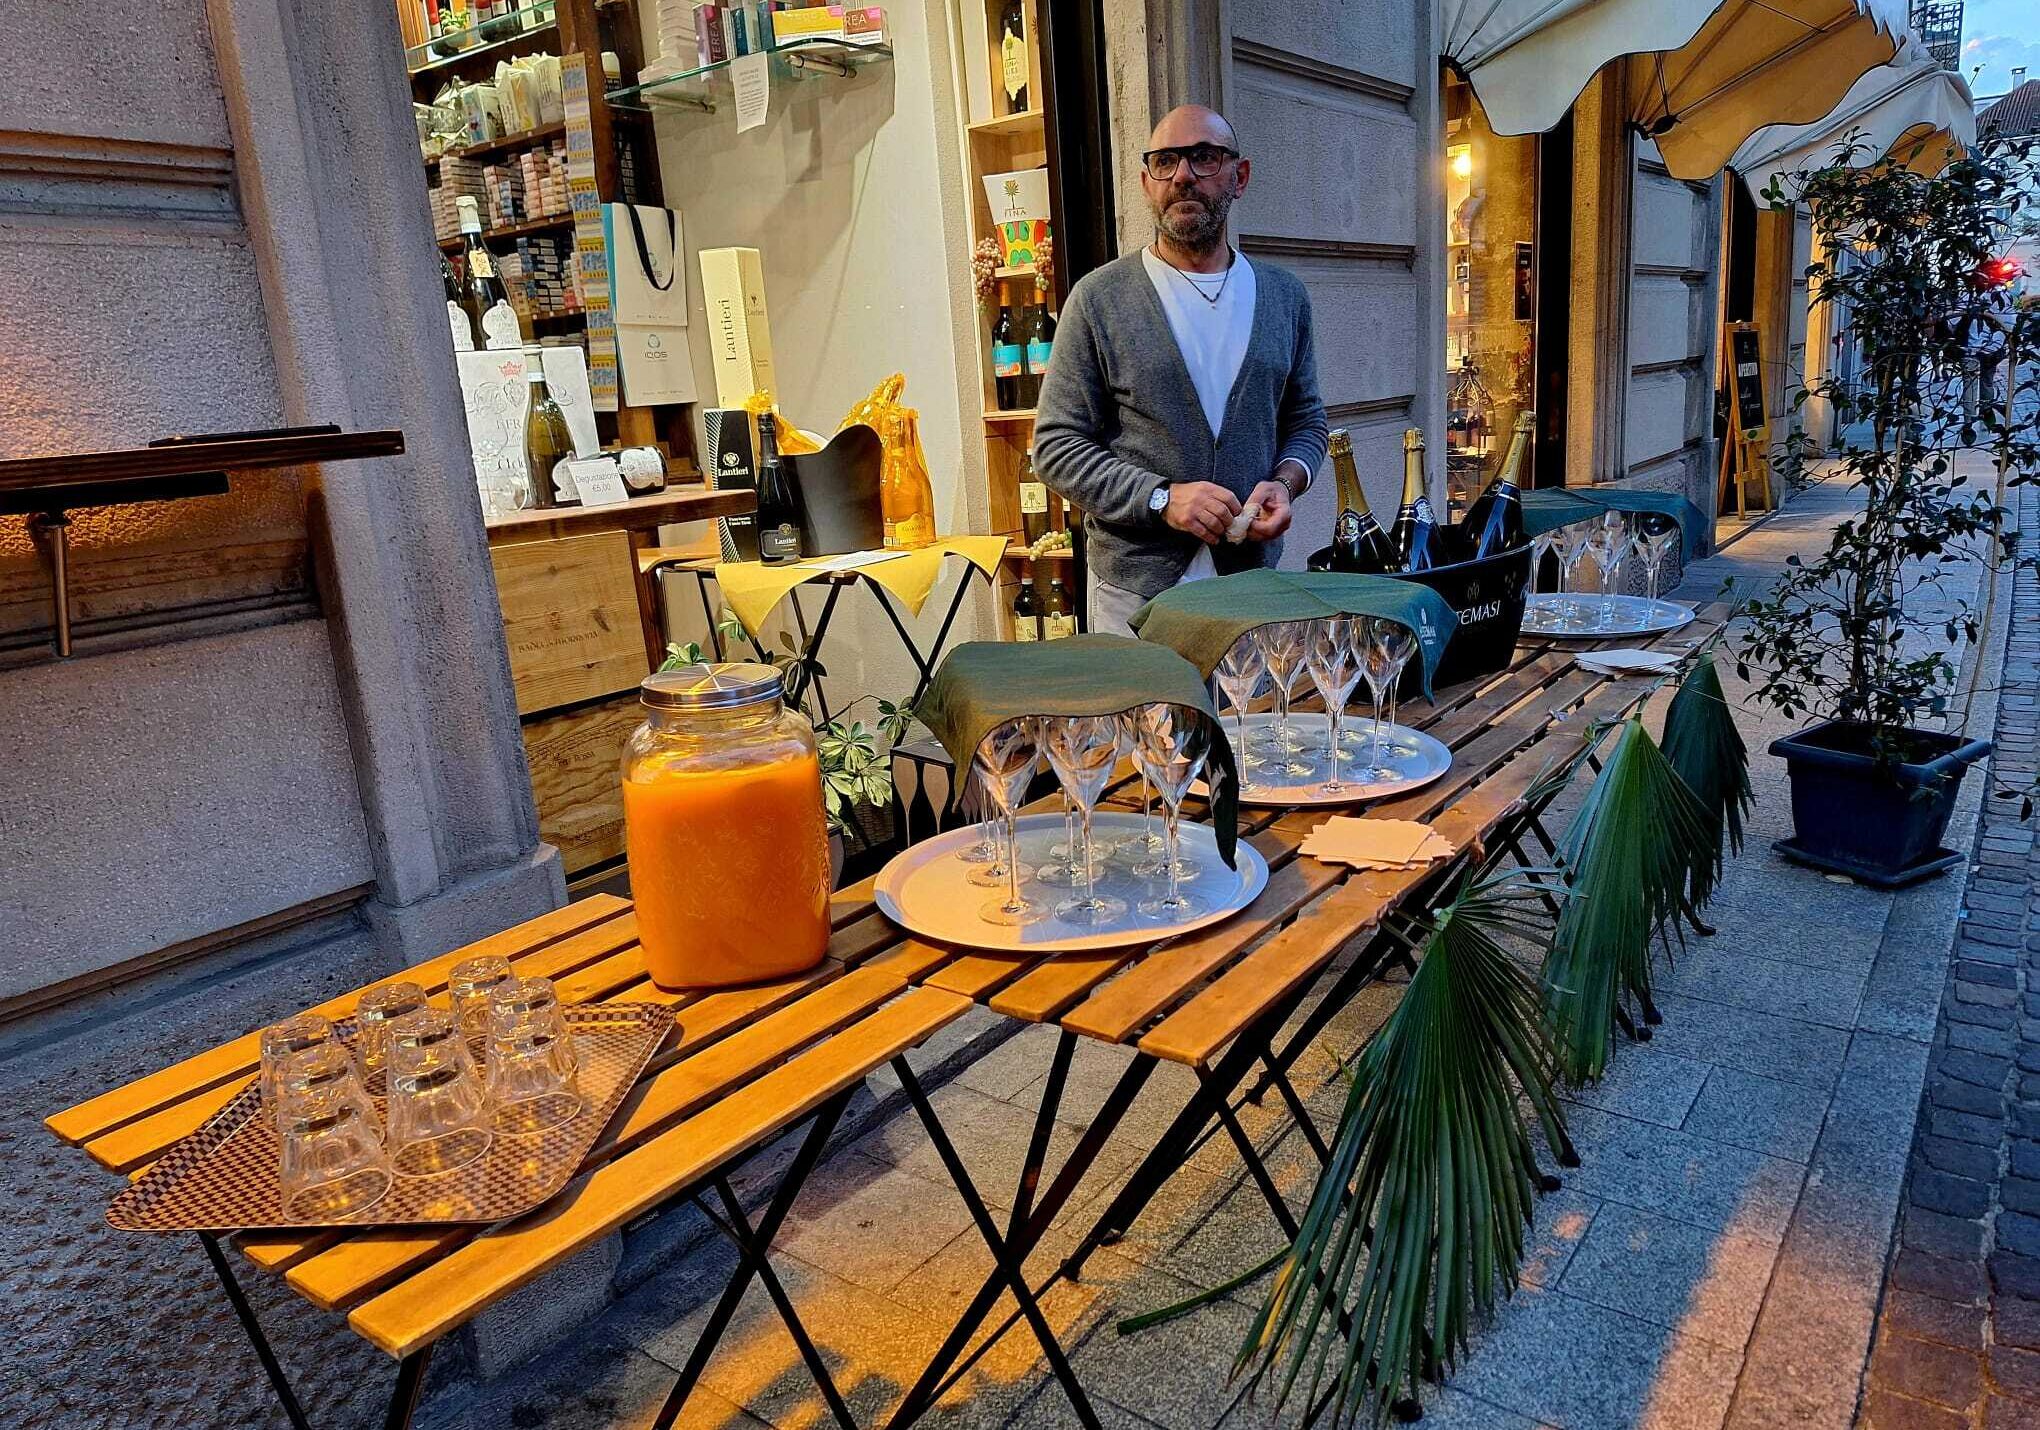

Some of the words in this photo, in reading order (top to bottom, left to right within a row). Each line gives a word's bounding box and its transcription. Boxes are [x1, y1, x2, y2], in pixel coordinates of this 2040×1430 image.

[710, 21, 722, 61] TEREA
[718, 299, 737, 362] Lantieri
[644, 351, 668, 360] IQOS
[718, 467, 749, 477] Lantieri
